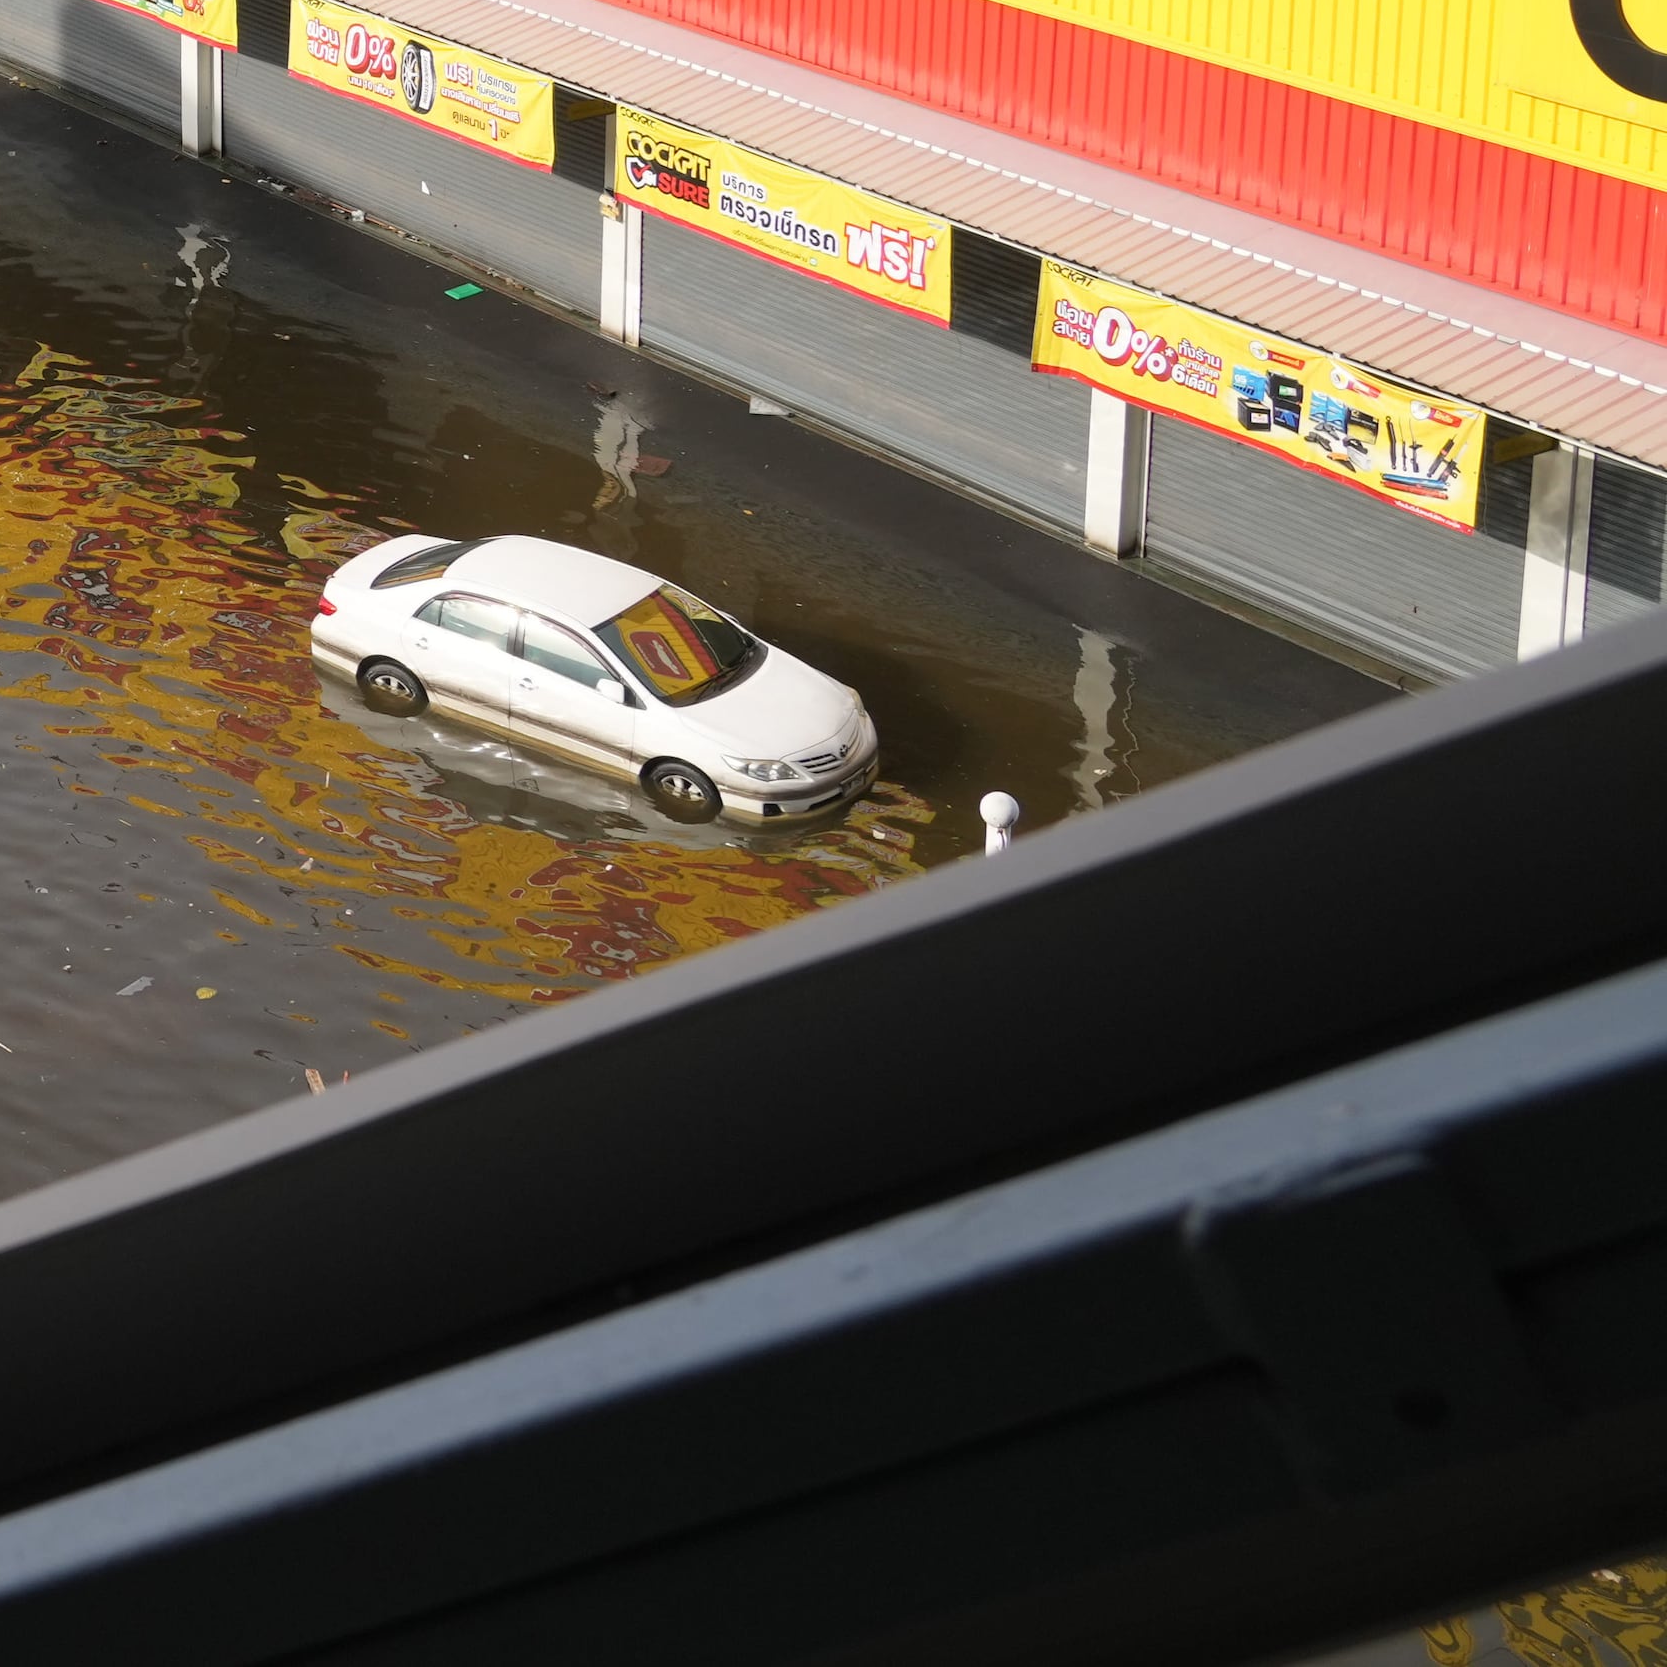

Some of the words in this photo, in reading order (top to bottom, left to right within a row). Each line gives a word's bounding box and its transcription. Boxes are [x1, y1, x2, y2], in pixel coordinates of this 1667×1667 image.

[307, 18, 339, 45] ผ่อน
[307, 39, 339, 66] สบาย
[345, 23, 396, 80] 0%
[444, 62, 474, 89] ฟรี!
[477, 68, 517, 94] โปรแกรม
[452, 111, 486, 131] ดูแลนาน
[488, 118, 498, 141] 1
[627, 130, 711, 182] COCKPIT
[657, 172, 710, 210] SURE
[722, 173, 765, 200] บริการ
[720, 193, 837, 253] ตรวจเช็กรถ
[1046, 260, 1094, 287] COCKPIT
[1053, 320, 1092, 349] สบาย
[1178, 338, 1223, 372] ทั้งร้าน
